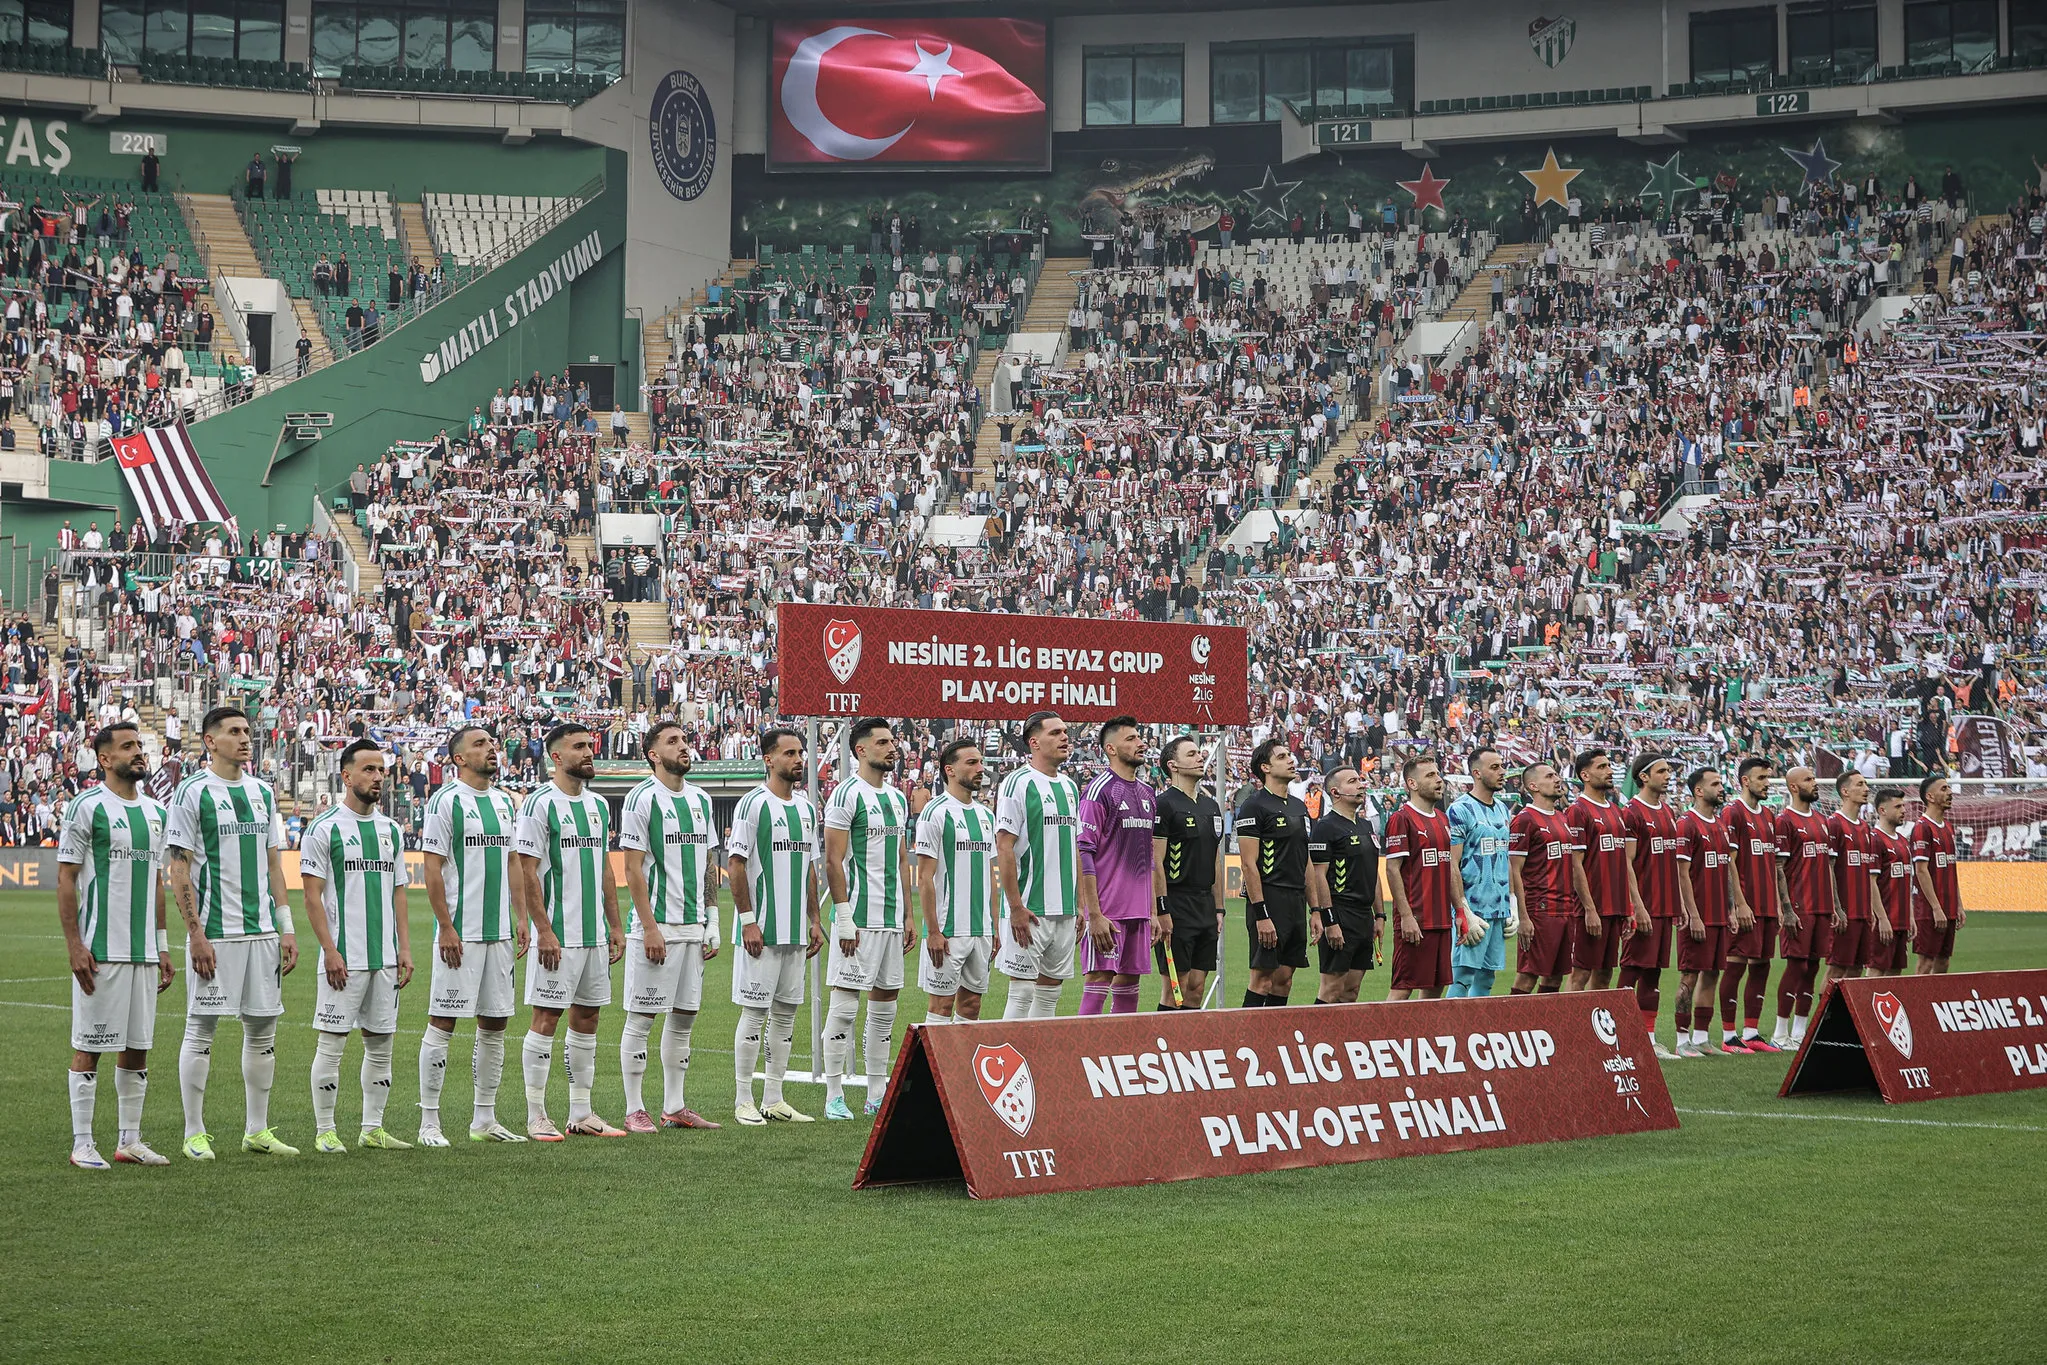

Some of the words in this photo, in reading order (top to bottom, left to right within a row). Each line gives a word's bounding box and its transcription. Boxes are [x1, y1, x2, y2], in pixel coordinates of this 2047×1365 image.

[669, 73, 700, 100] BURSA
[1768, 94, 1798, 113] 122
[122, 134, 154, 152] 220
[1331, 124, 1360, 142] 121
[0, 116, 71, 176] AŞ
[440, 308, 499, 374] MATLI
[505, 230, 602, 328] STADYUMU
[246, 559, 281, 580] 120
[888, 634, 967, 667] NESİNE
[973, 644, 992, 668] 2.
[998, 638, 1031, 669] LİG
[1036, 647, 1104, 672] BEYAZ
[1108, 651, 1164, 674] GRUP
[1189, 671, 1215, 685] NESİNE
[941, 679, 1045, 705] PLAY-OFF
[1051, 675, 1117, 706] FİNALİ
[826, 692, 861, 712] TFF
[665, 831, 707, 844] mikroman
[344, 858, 394, 873] mikroman
[1931, 988, 2021, 1033] NESİNE
[2017, 996, 2044, 1026] 2.
[1081, 1037, 1236, 1099] NESİNE
[1236, 1046, 1277, 1087] 2.
[1277, 1030, 1343, 1085] LİG
[1343, 1035, 1466, 1080] BEYAZ
[1466, 1029, 1556, 1071] GRUP
[1014, 1074, 1028, 1092] 1923
[1899, 1067, 1931, 1089] TFF
[1200, 1103, 1385, 1157] PLAY-OFF
[1388, 1080, 1506, 1141] FİNALİ
[1003, 1148, 1056, 1179] TFF
